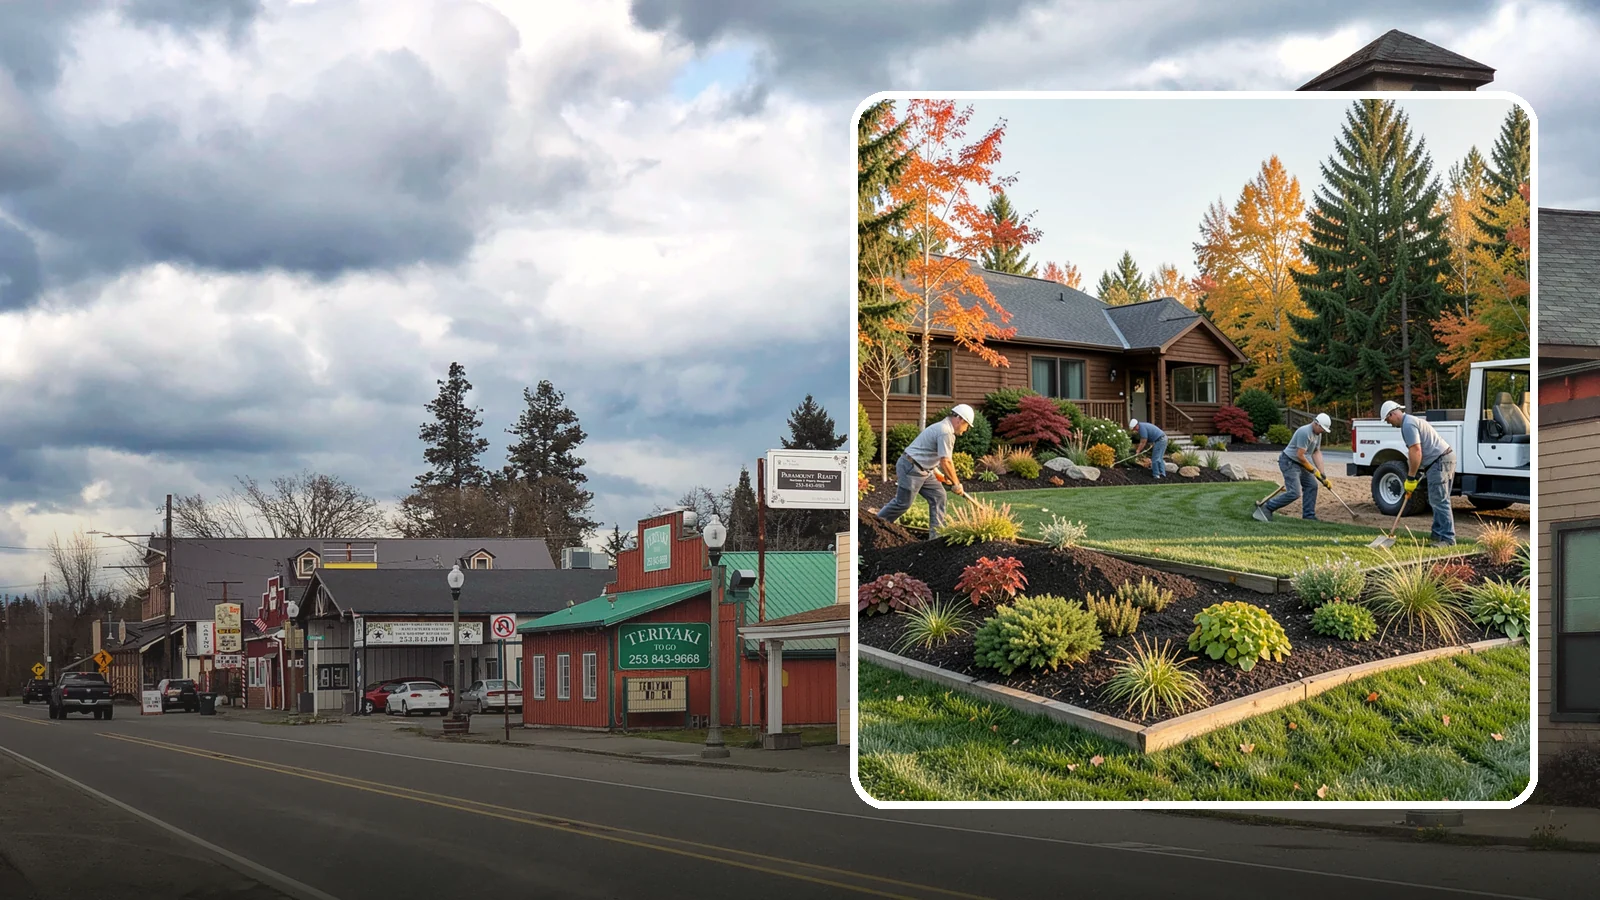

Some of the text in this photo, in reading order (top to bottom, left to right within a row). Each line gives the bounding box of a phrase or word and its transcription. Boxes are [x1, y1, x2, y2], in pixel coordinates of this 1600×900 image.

[624, 627, 702, 646] TERIYAKI
[629, 654, 700, 664] 253 843-9668
